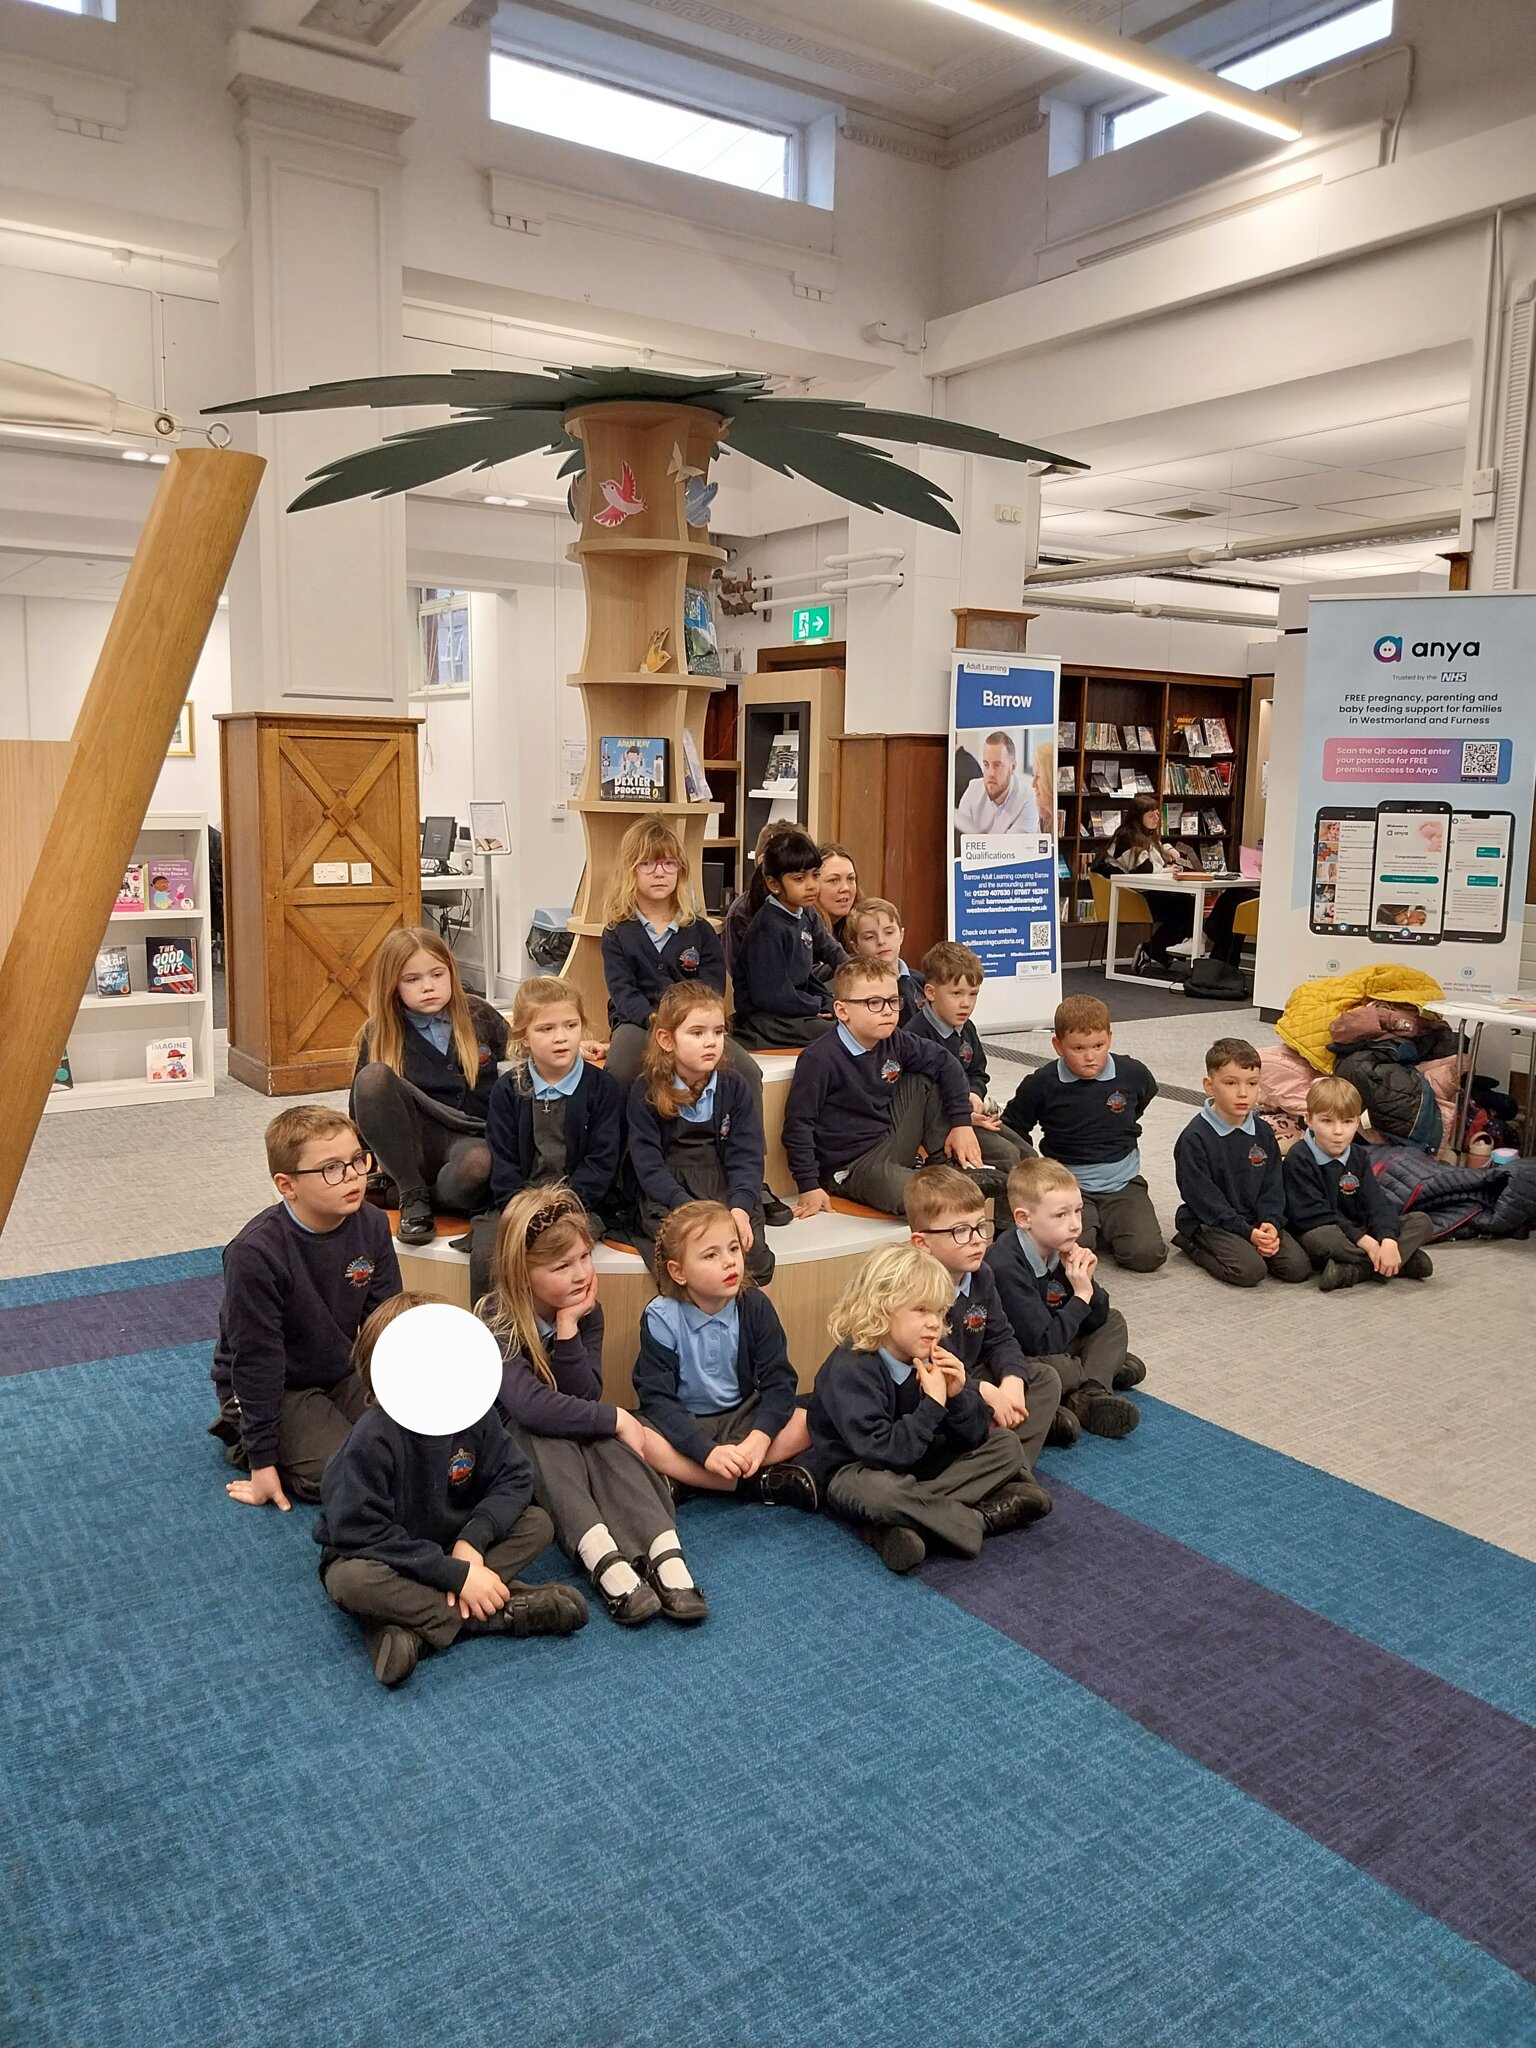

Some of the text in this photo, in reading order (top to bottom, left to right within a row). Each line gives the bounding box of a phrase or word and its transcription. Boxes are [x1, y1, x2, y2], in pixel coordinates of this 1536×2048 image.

[1412, 641, 1480, 662] anya
[966, 662, 1007, 673] Adult Learning
[1441, 672, 1467, 682] NHS
[983, 690, 1032, 708] Barrow
[1345, 693, 1498, 704] FREE pregnancy, parenting and
[1339, 704, 1502, 715] baby feeding support for families
[1349, 716, 1490, 724] in Westmorland and Furness
[1373, 747, 1386, 755] QR
[1387, 747, 1408, 755] code
[1409, 747, 1427, 755] and
[1336, 757, 1355, 766] your
[1356, 757, 1395, 766] postcode
[1409, 757, 1428, 765] FREE
[1335, 766, 1374, 775] premium
[1415, 767, 1438, 775] Anya
[614, 776, 651, 787] DEXTER
[614, 786, 651, 796] PROCTER
[965, 841, 987, 850] FREE
[965, 851, 1016, 861] Qualifications
[993, 873, 1014, 881] Learning
[1014, 873, 1034, 881] covering
[996, 881, 1024, 889] surrounding
[997, 927, 1018, 935] website
[159, 944, 175, 953] THE
[100, 953, 125, 968] Star
[152, 949, 185, 967] GOOD
[157, 963, 183, 975] GUYS
[151, 1042, 188, 1051] IMAGINE
